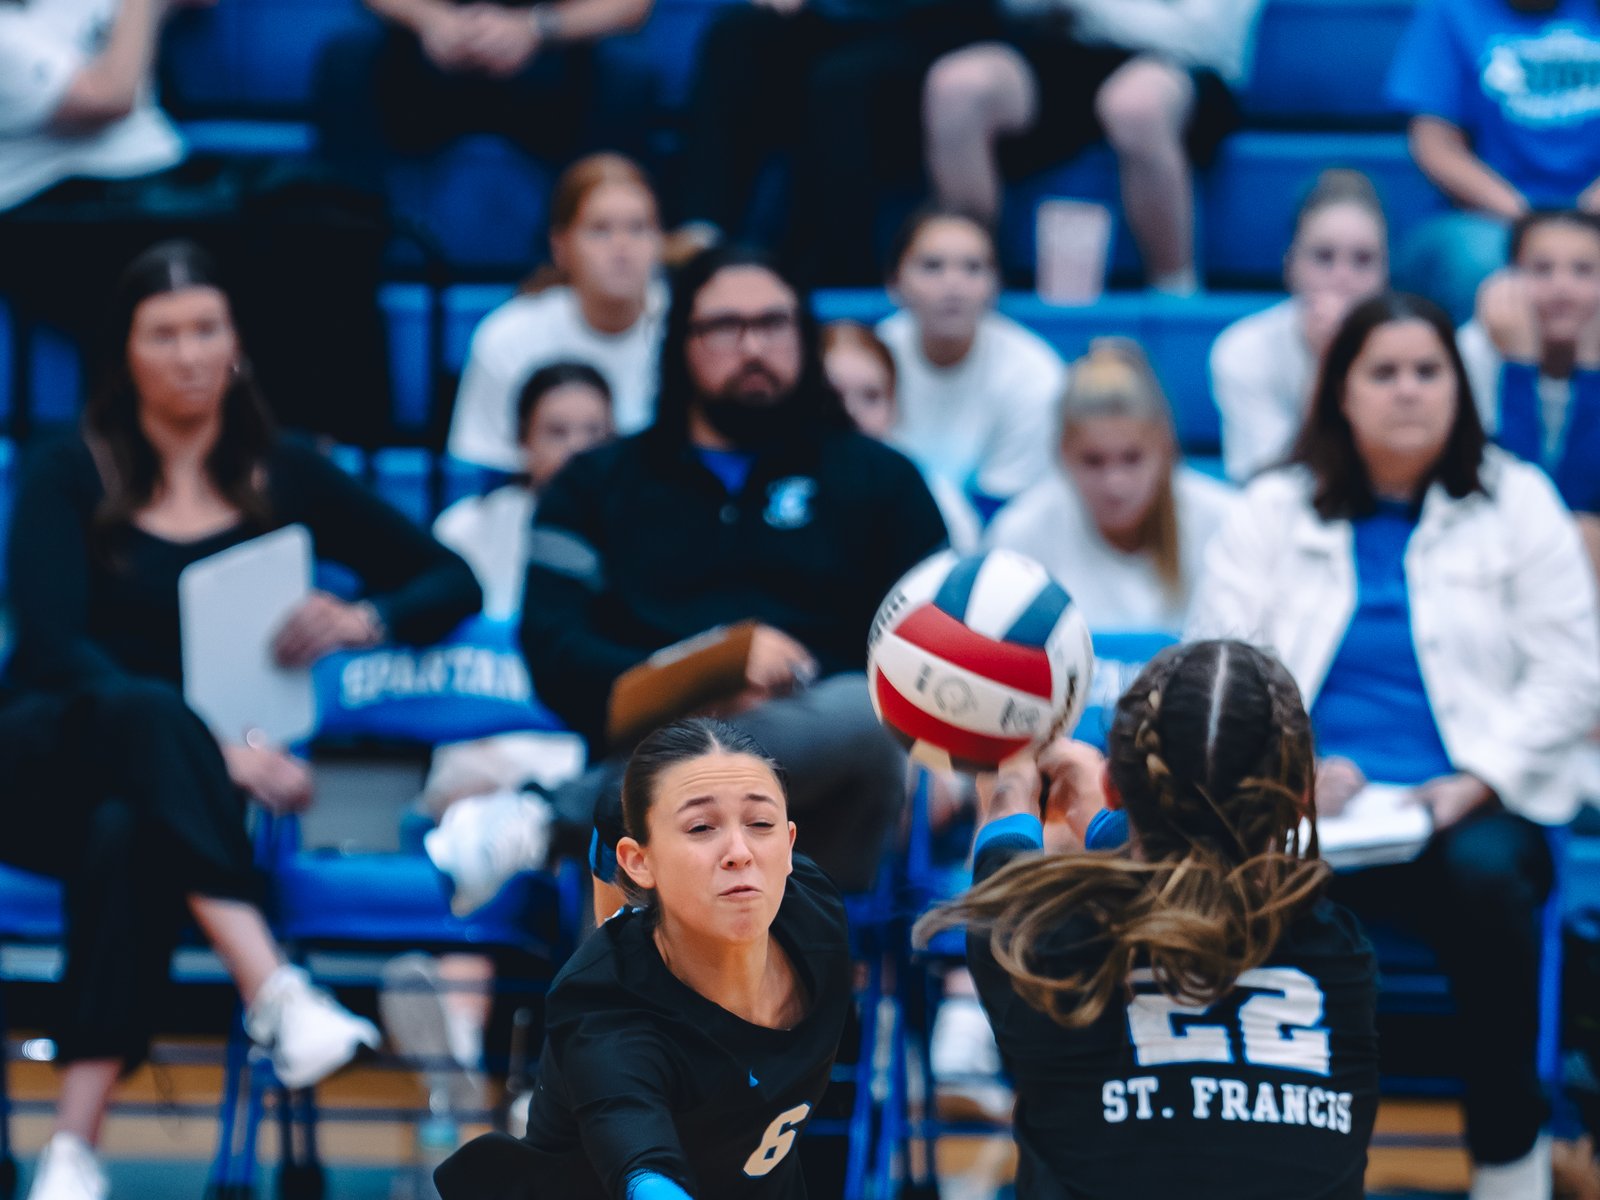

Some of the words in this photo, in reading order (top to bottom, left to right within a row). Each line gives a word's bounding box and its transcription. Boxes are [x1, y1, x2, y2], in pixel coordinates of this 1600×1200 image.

[1102, 1076, 1175, 1123] ST.
[1190, 1076, 1353, 1135] FRANCIS
[742, 1102, 811, 1177] 6
